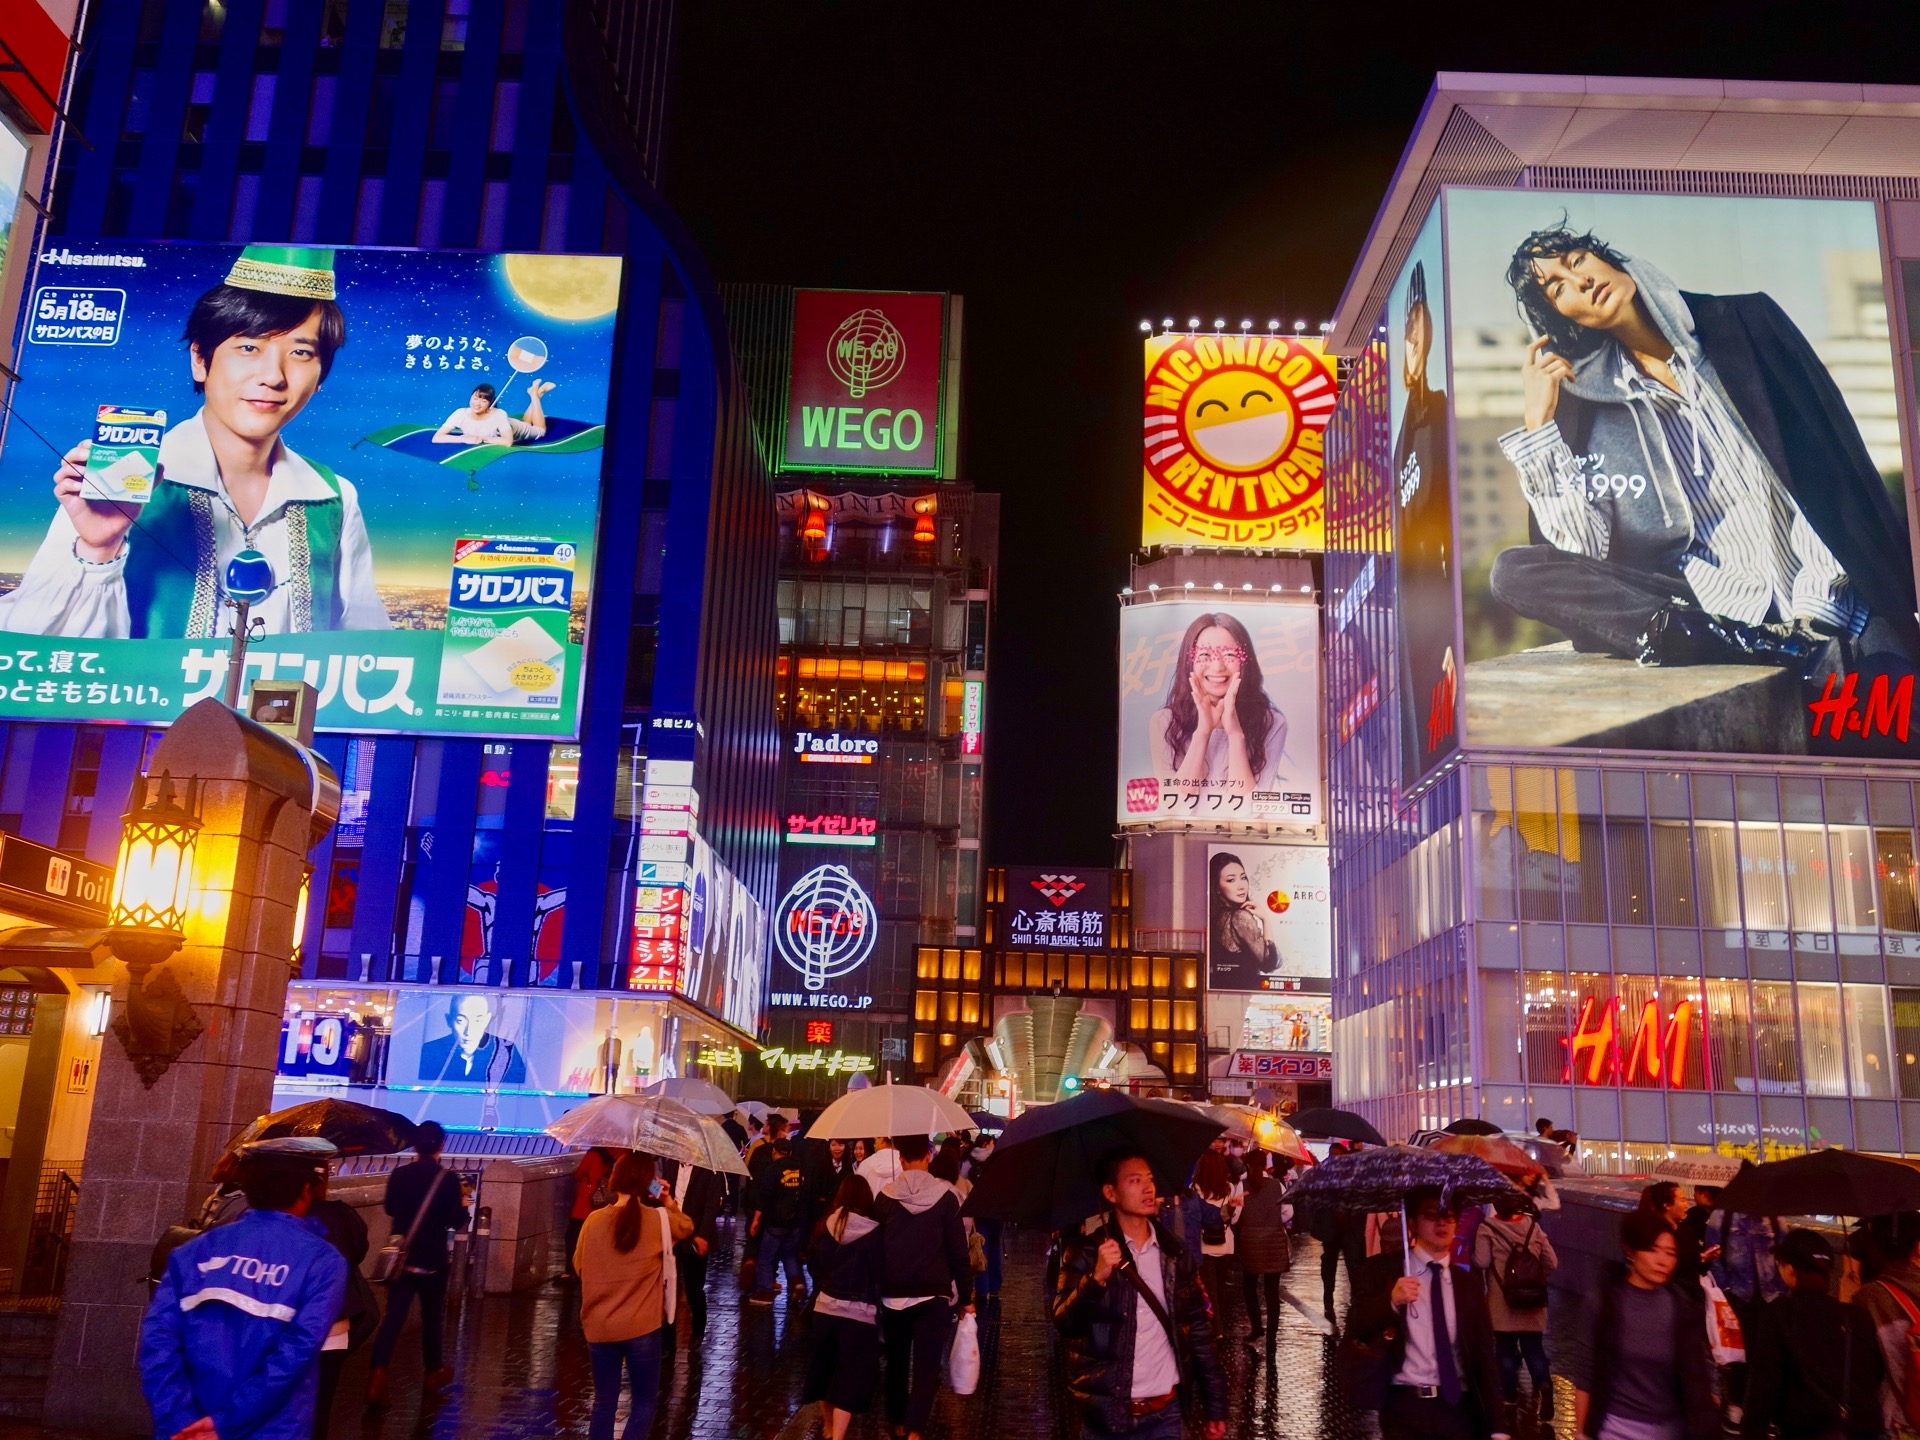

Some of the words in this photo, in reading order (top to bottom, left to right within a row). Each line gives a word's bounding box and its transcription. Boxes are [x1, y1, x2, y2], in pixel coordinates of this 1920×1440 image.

[40, 249, 147, 267] Hisamitsu
[39, 299, 117, 322] 5月18日は
[35, 324, 114, 341] サロンパスの日
[405, 334, 492, 352] 夢のような、
[405, 354, 491, 372] きもちよさ。
[1146, 336, 1313, 411] NICONICO
[98, 425, 160, 445] サロンパス
[802, 406, 924, 451] WEGO
[1162, 428, 1324, 512] RENTACAR
[1554, 451, 1605, 472] シャツ
[1555, 473, 1647, 502] ¥1,999
[1147, 492, 1324, 542] ニコニコレンタカ
[556, 547, 572, 557] 40
[458, 573, 566, 605] サロンパス
[181, 648, 415, 717] サロンパス
[1808, 672, 1915, 743] H&M
[793, 732, 879, 753] J'adore
[1163, 793, 1244, 811] ワクワク
[787, 815, 877, 836] サイゼリヤ
[1011, 909, 1104, 935] 心斎橋筋
[1011, 933, 1032, 945] SHIN
[771, 992, 873, 1009] WWW.WEGO.JP
[807, 1021, 832, 1043] 薬
[760, 1048, 875, 1076] マツモトキヨシ
[1257, 1057, 1316, 1075] ダイコク
[231, 1256, 290, 1286] TOHO
